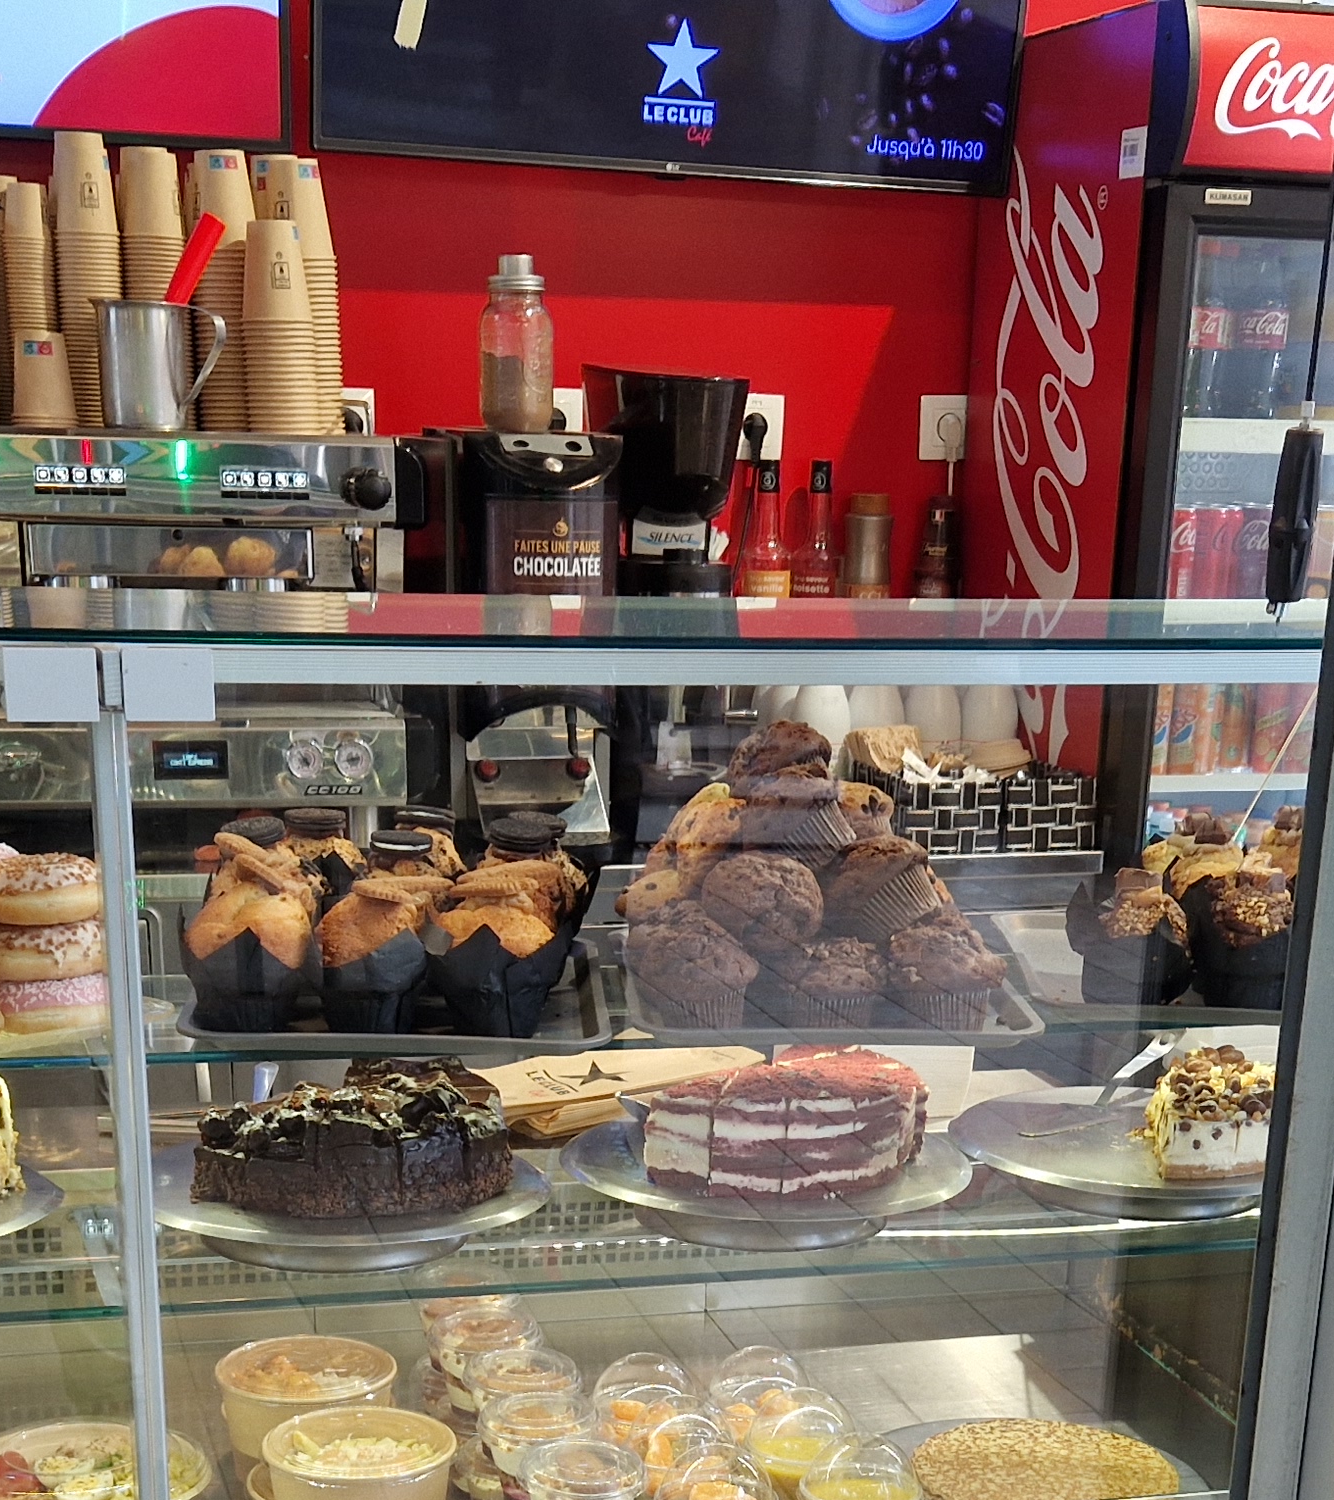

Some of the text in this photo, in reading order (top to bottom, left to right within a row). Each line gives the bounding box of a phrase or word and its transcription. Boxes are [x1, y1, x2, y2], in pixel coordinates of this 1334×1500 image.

[685, 126, 713, 147] Café
[940, 138, 984, 162] 11h30
[514, 540, 601, 554] FAITES UNE PAUSE
[513, 554, 601, 577] CHOCOLATÉE
[750, 583, 784, 593] vanille
